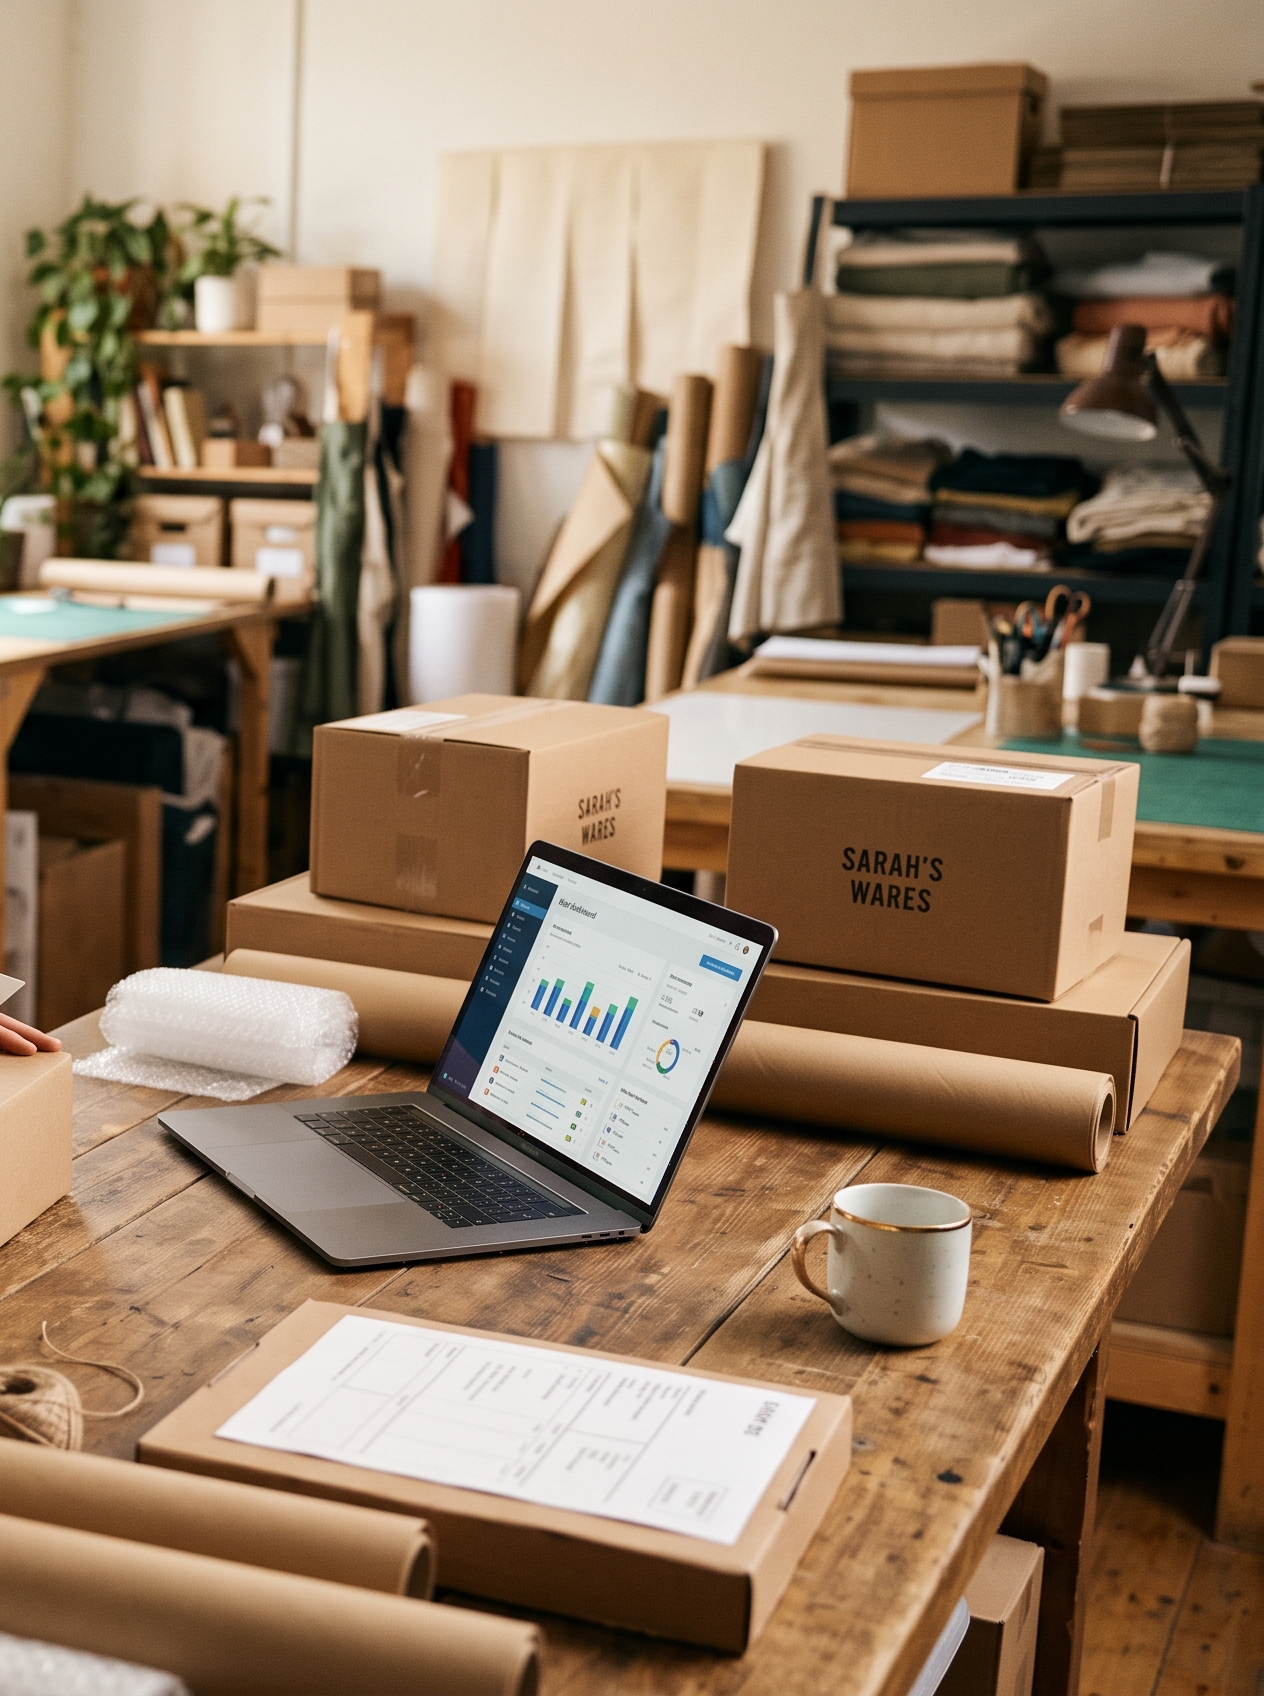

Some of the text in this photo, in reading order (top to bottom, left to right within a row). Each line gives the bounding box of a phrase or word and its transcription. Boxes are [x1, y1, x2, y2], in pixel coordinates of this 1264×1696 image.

[578, 787, 621, 819] SARAH'S
[581, 816, 616, 846] WARES
[842, 847, 943, 882] SARAH'S
[851, 880, 931, 913] WARES
